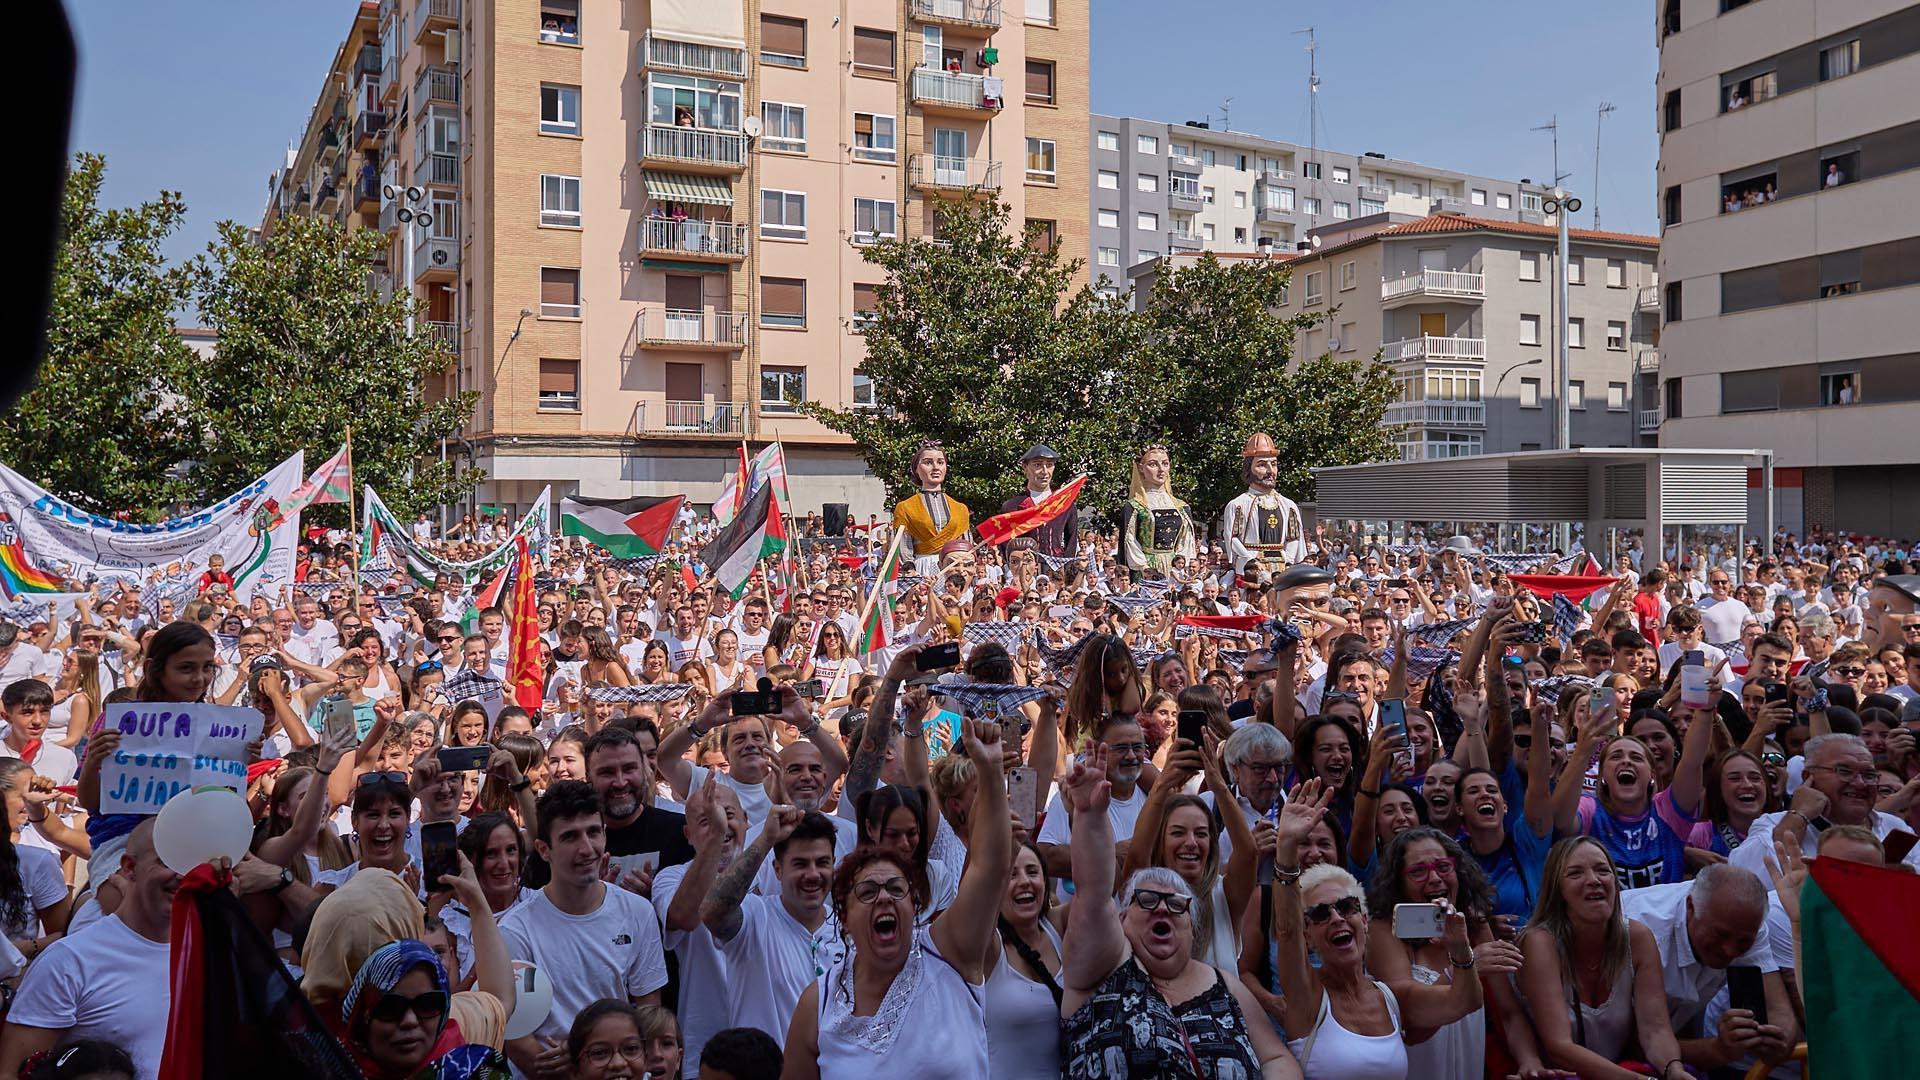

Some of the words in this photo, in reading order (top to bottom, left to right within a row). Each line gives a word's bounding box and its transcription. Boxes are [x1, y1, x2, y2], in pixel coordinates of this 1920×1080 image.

[118, 711, 191, 738] AUPA
[115, 750, 177, 769] GORA
[1623, 828, 1642, 851] 13
